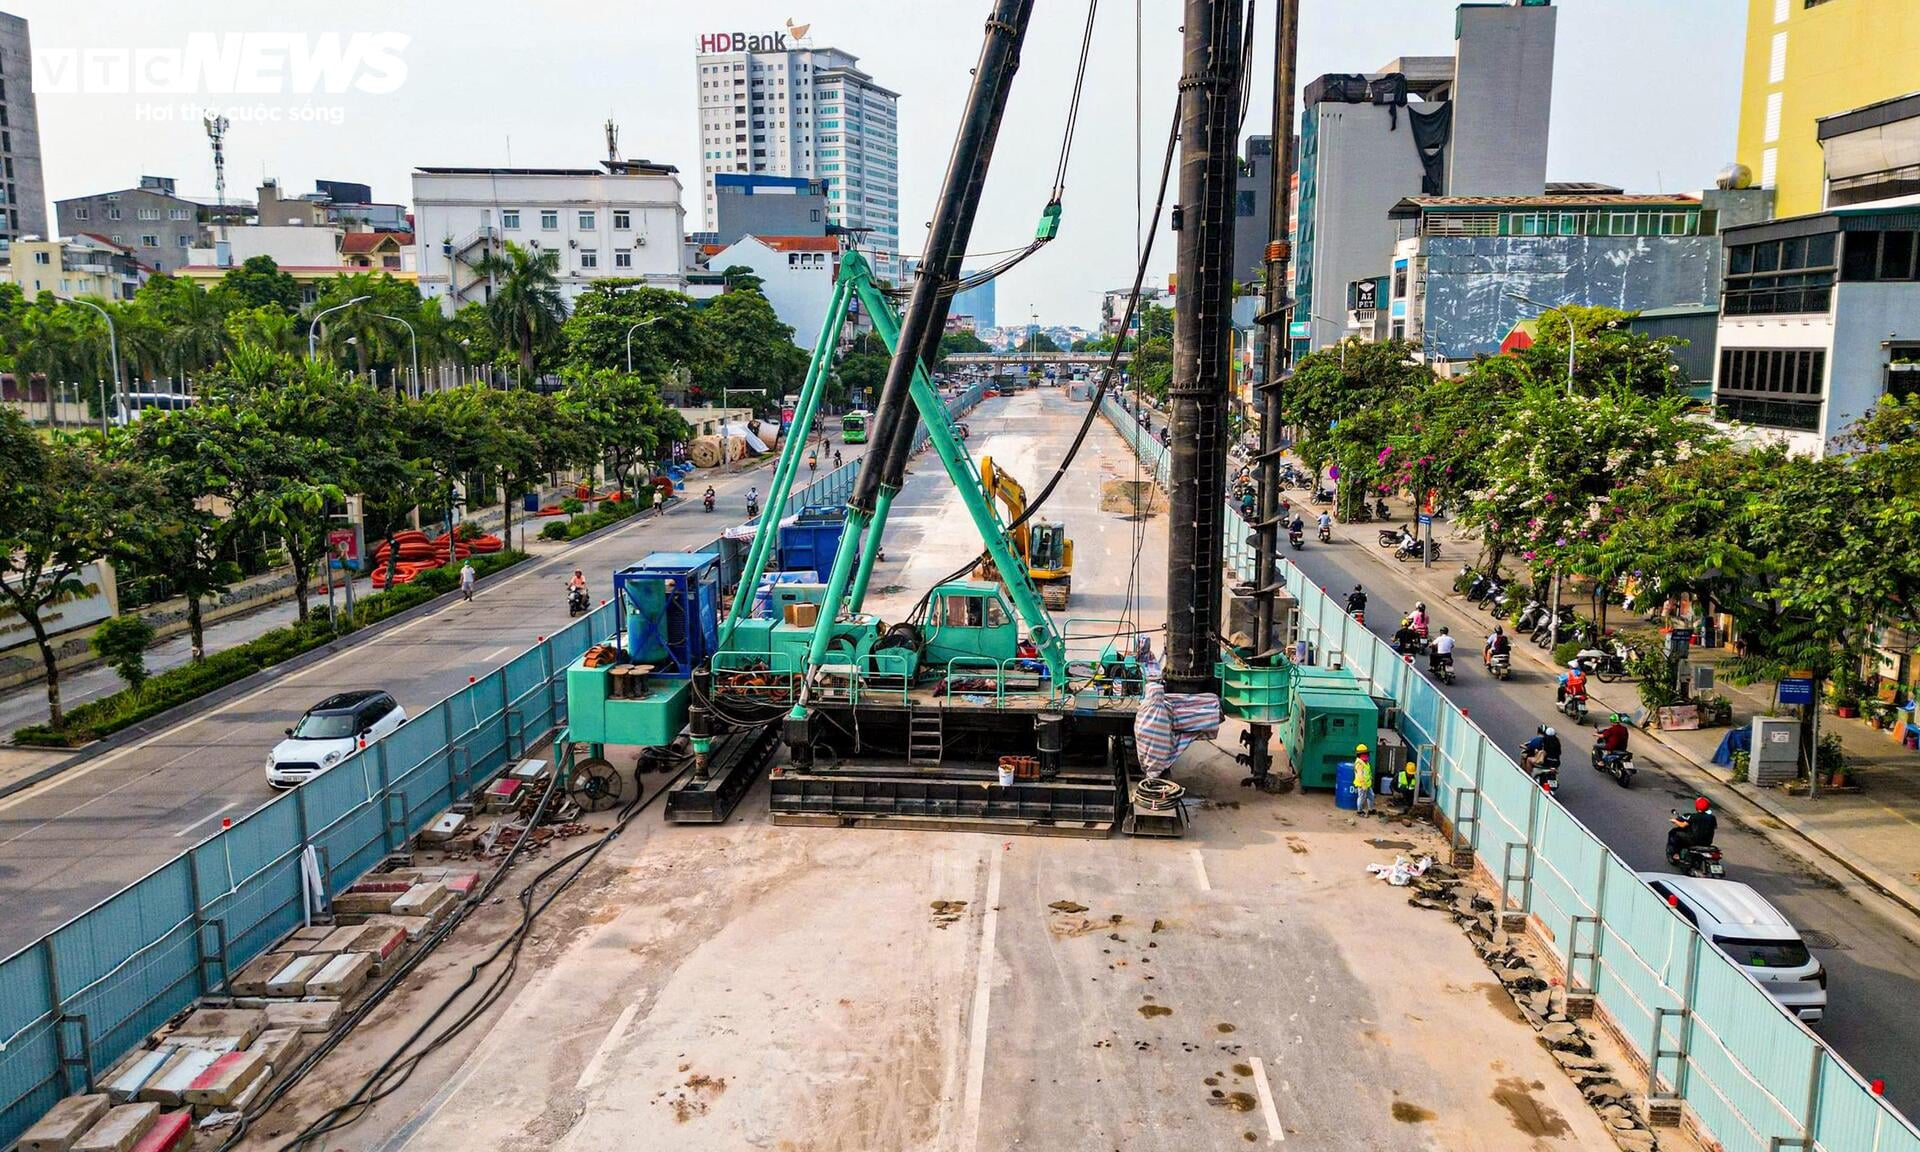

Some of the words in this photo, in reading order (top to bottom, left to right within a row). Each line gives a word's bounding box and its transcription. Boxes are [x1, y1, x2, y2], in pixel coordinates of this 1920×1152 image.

[701, 31, 787, 53] HDBank
[1361, 292, 1373, 301] AZ
[1358, 300, 1374, 308] PET
